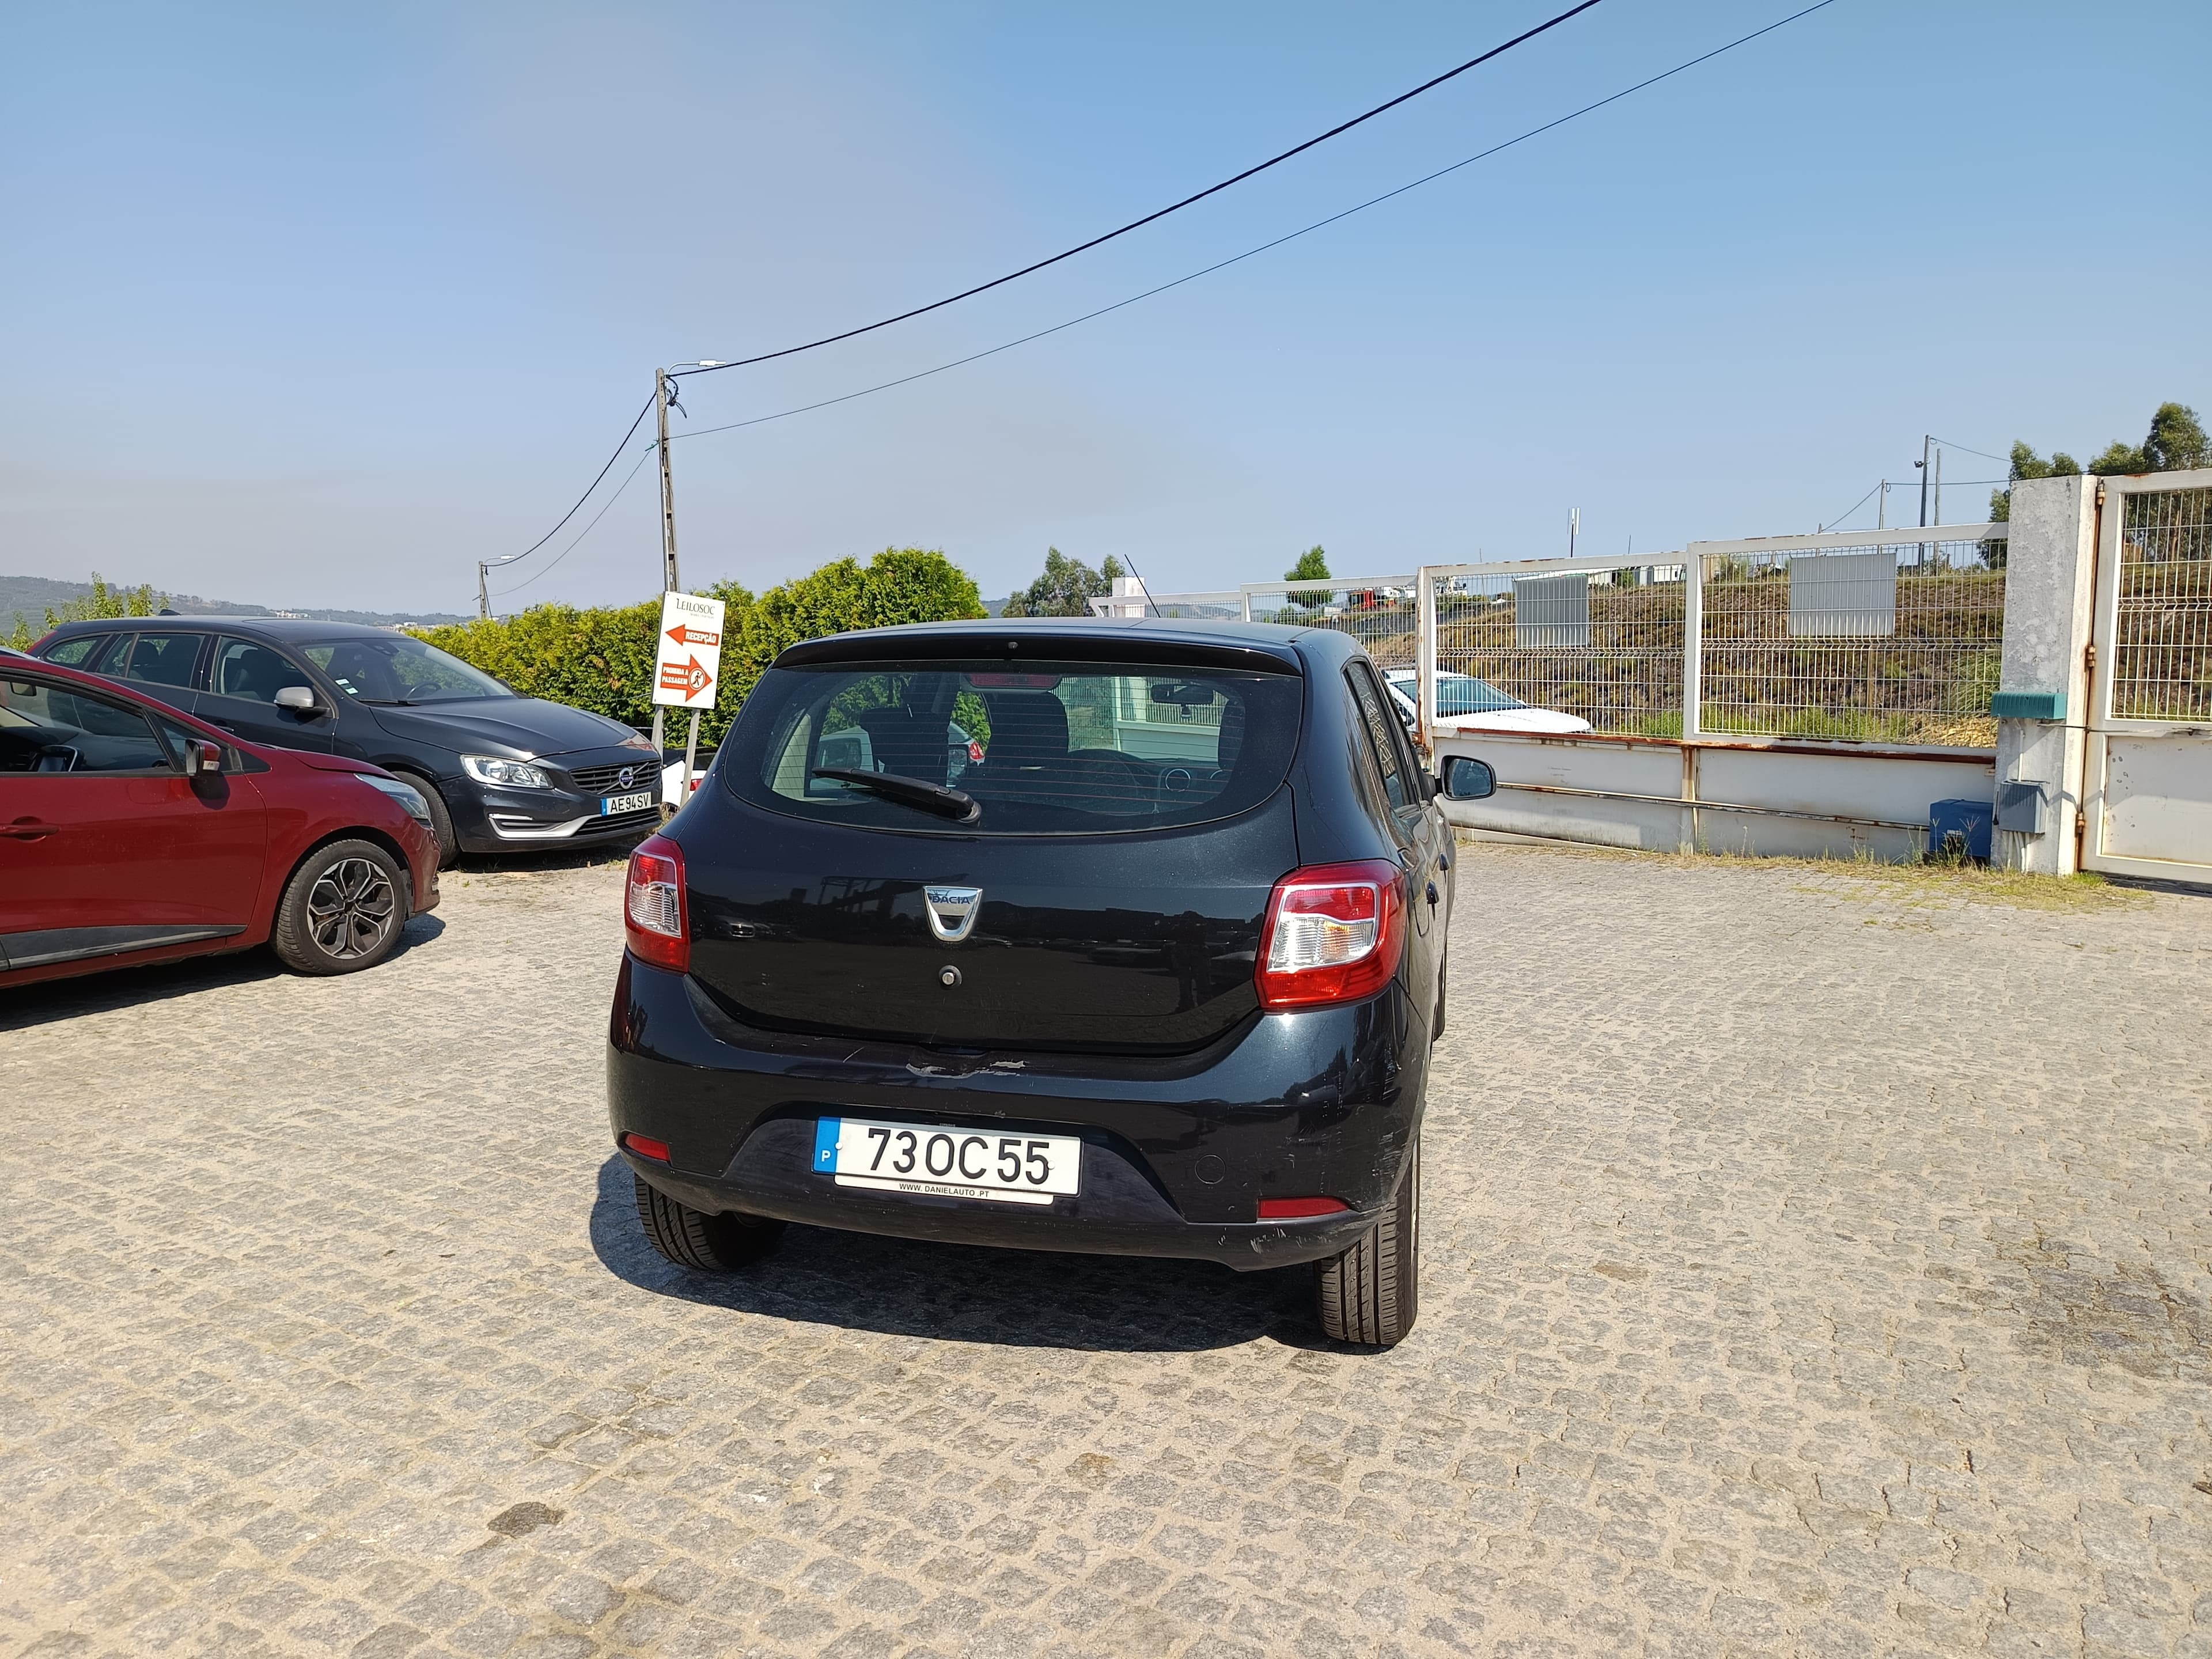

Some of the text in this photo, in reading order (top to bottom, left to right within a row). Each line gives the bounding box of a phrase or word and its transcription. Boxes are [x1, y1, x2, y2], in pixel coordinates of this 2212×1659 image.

[676, 598, 715, 615] LEILOSOC
[685, 631, 717, 644] RECEPÇÃO
[932, 896, 970, 904] DACIA
[821, 1150, 831, 1162] P
